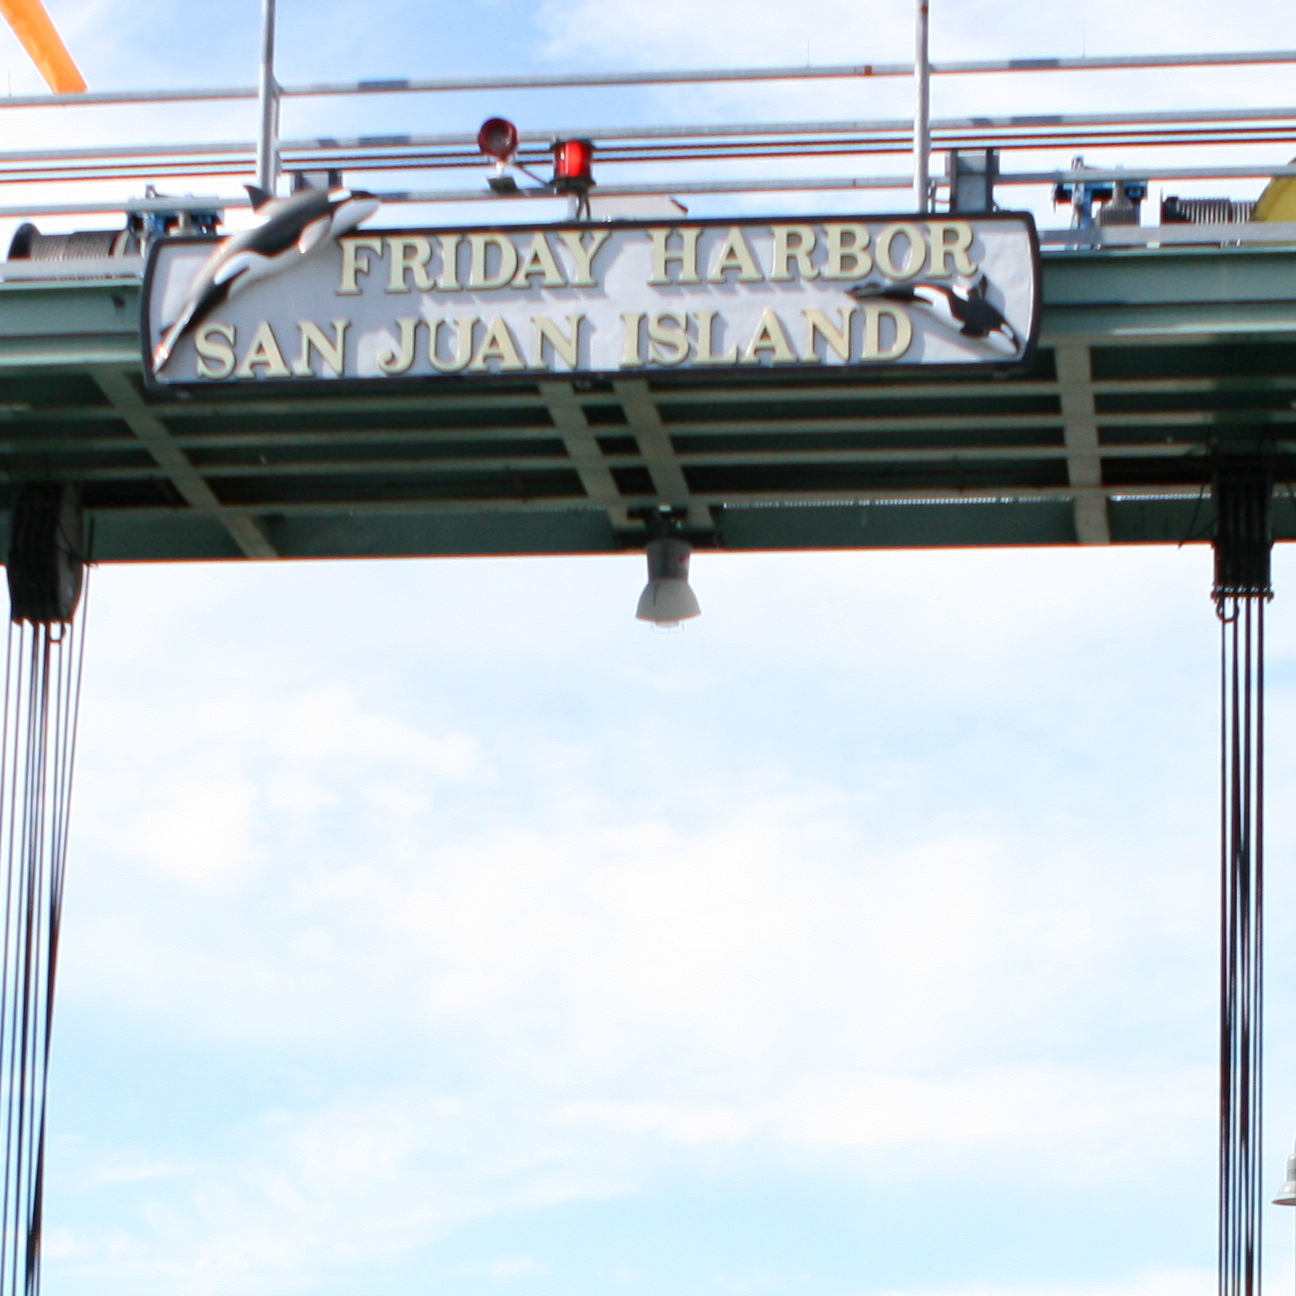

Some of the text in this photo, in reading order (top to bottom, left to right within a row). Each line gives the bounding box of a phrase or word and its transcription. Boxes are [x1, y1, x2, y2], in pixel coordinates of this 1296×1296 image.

[336, 220, 979, 296] FRIDAY HARBOR
[194, 304, 914, 380] SAN JUAN ISLAND
